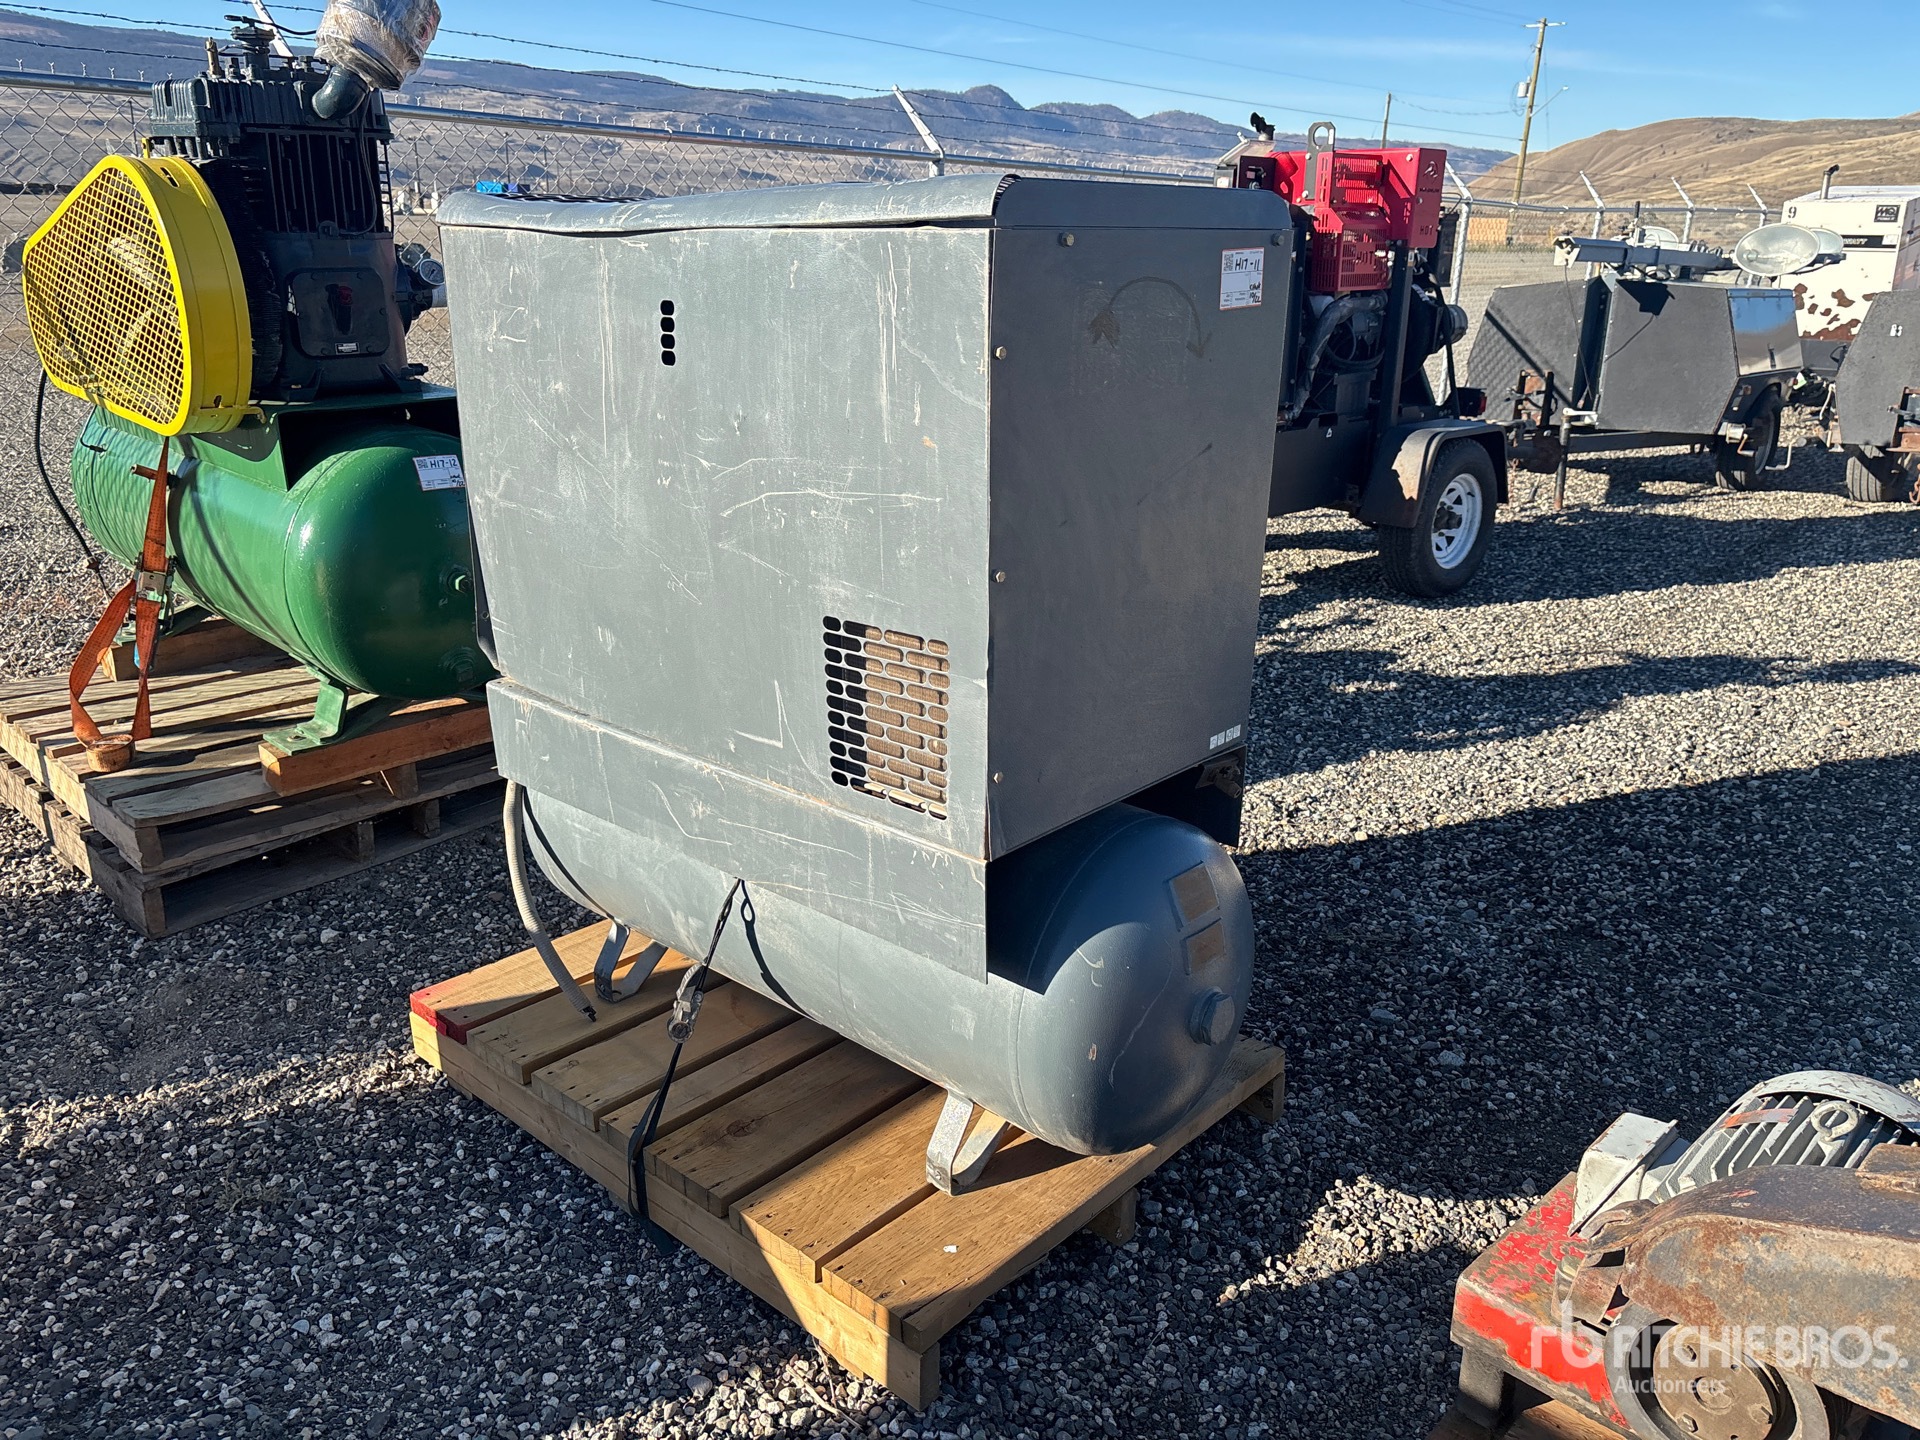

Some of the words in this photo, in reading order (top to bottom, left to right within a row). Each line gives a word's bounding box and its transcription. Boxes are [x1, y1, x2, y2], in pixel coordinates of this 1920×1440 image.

[1787, 206, 1797, 219] 9
[1419, 225, 1433, 235] HOT
[1356, 251, 1374, 265] HOT
[430, 458, 458, 468] H17-12
